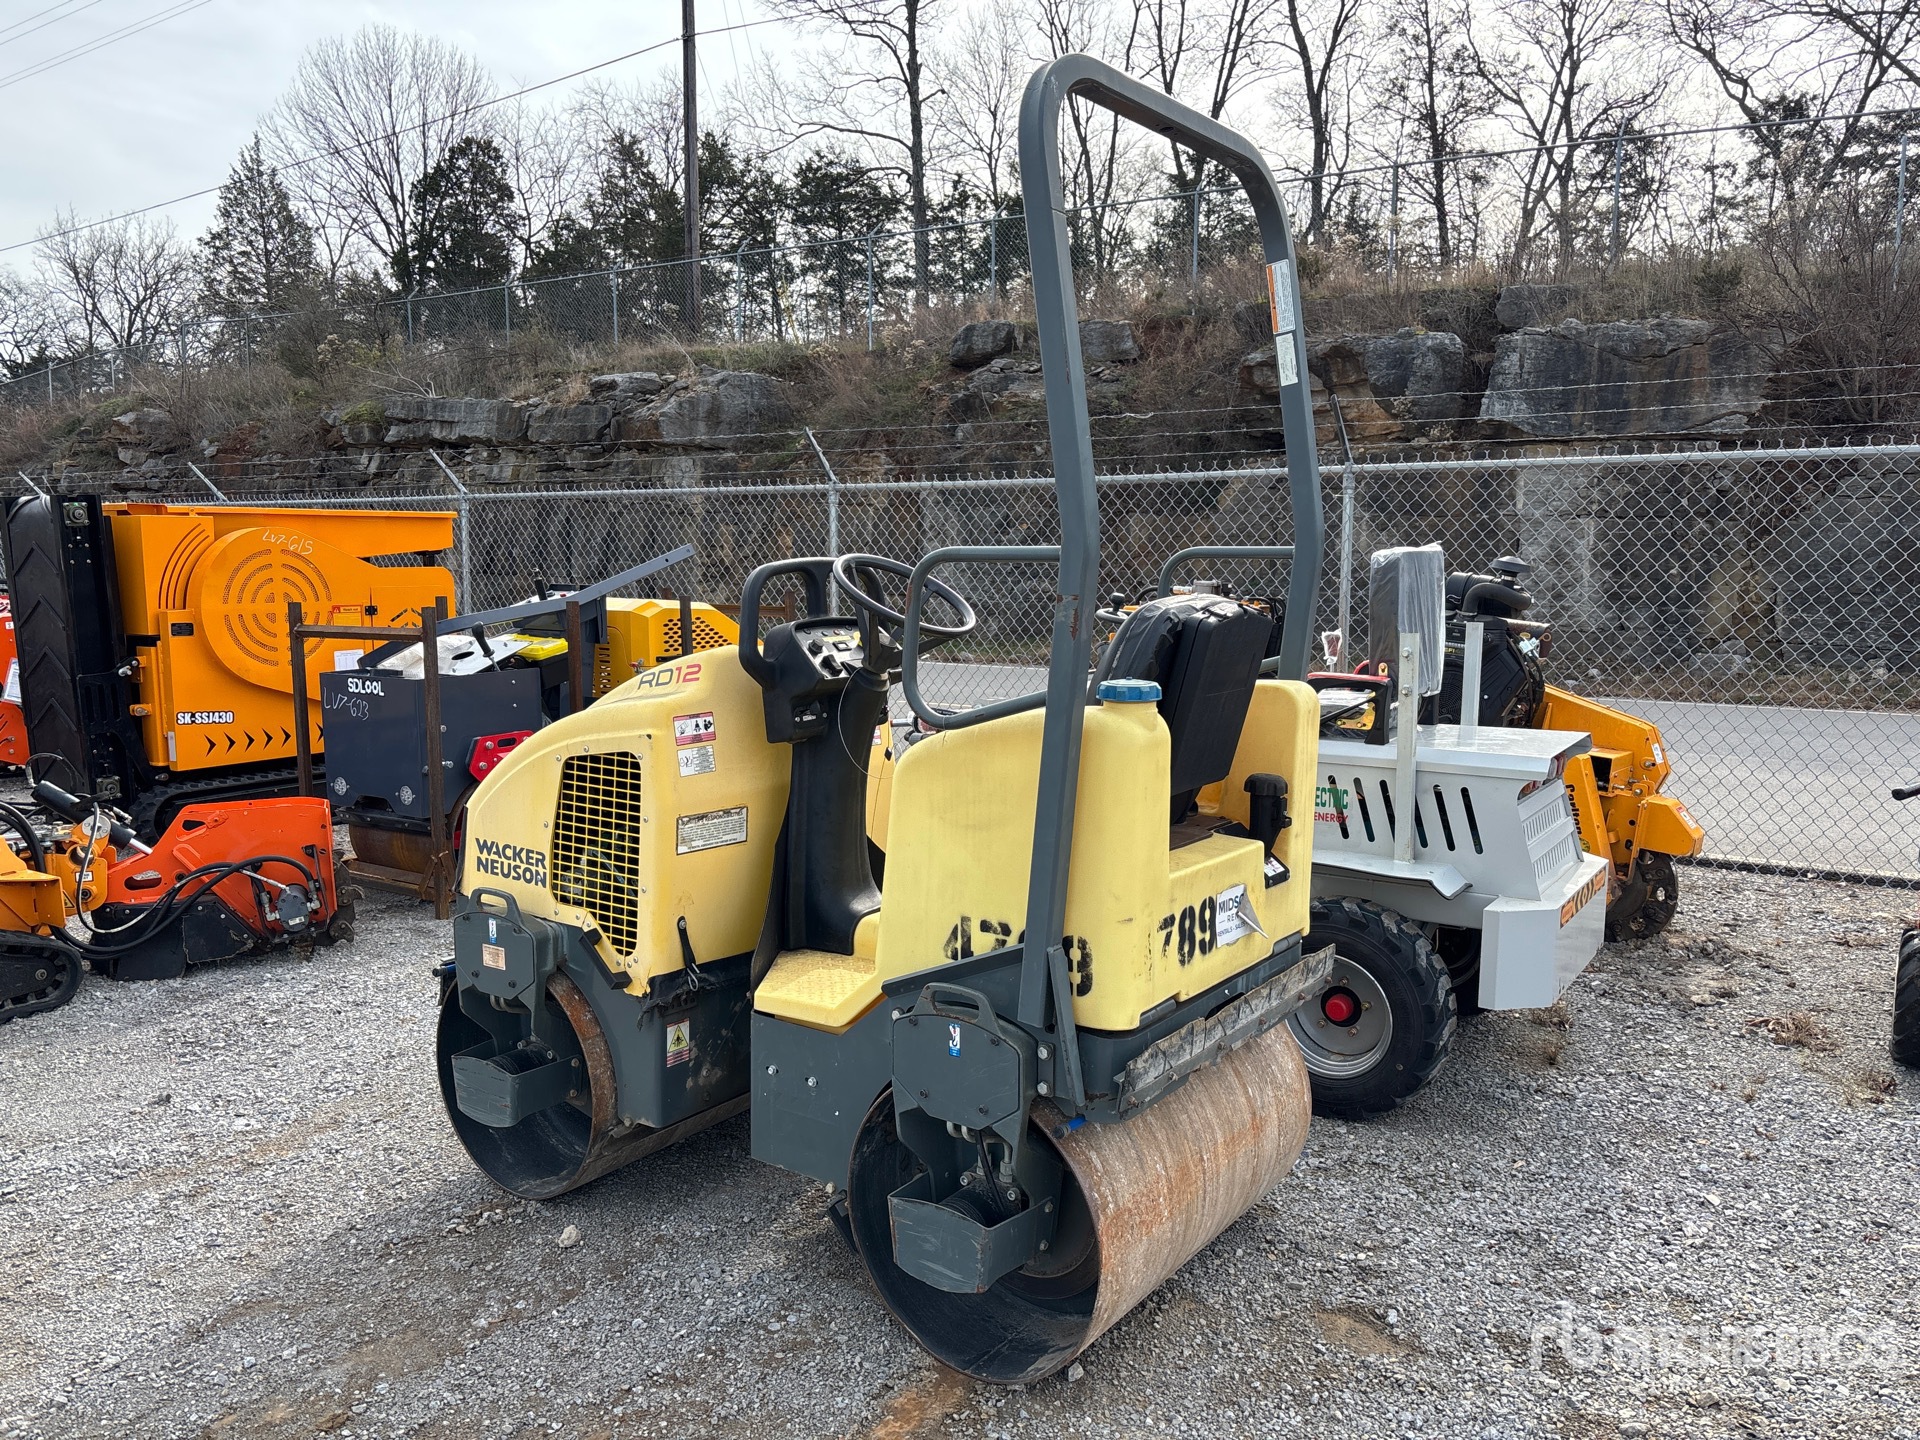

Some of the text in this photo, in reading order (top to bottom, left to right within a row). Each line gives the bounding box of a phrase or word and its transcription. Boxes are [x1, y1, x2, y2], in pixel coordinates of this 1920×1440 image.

[637, 664, 702, 690] RD12
[177, 711, 234, 725] SK-SSJ430
[475, 837, 547, 870] WACKER
[477, 856, 547, 889] NEUSON
